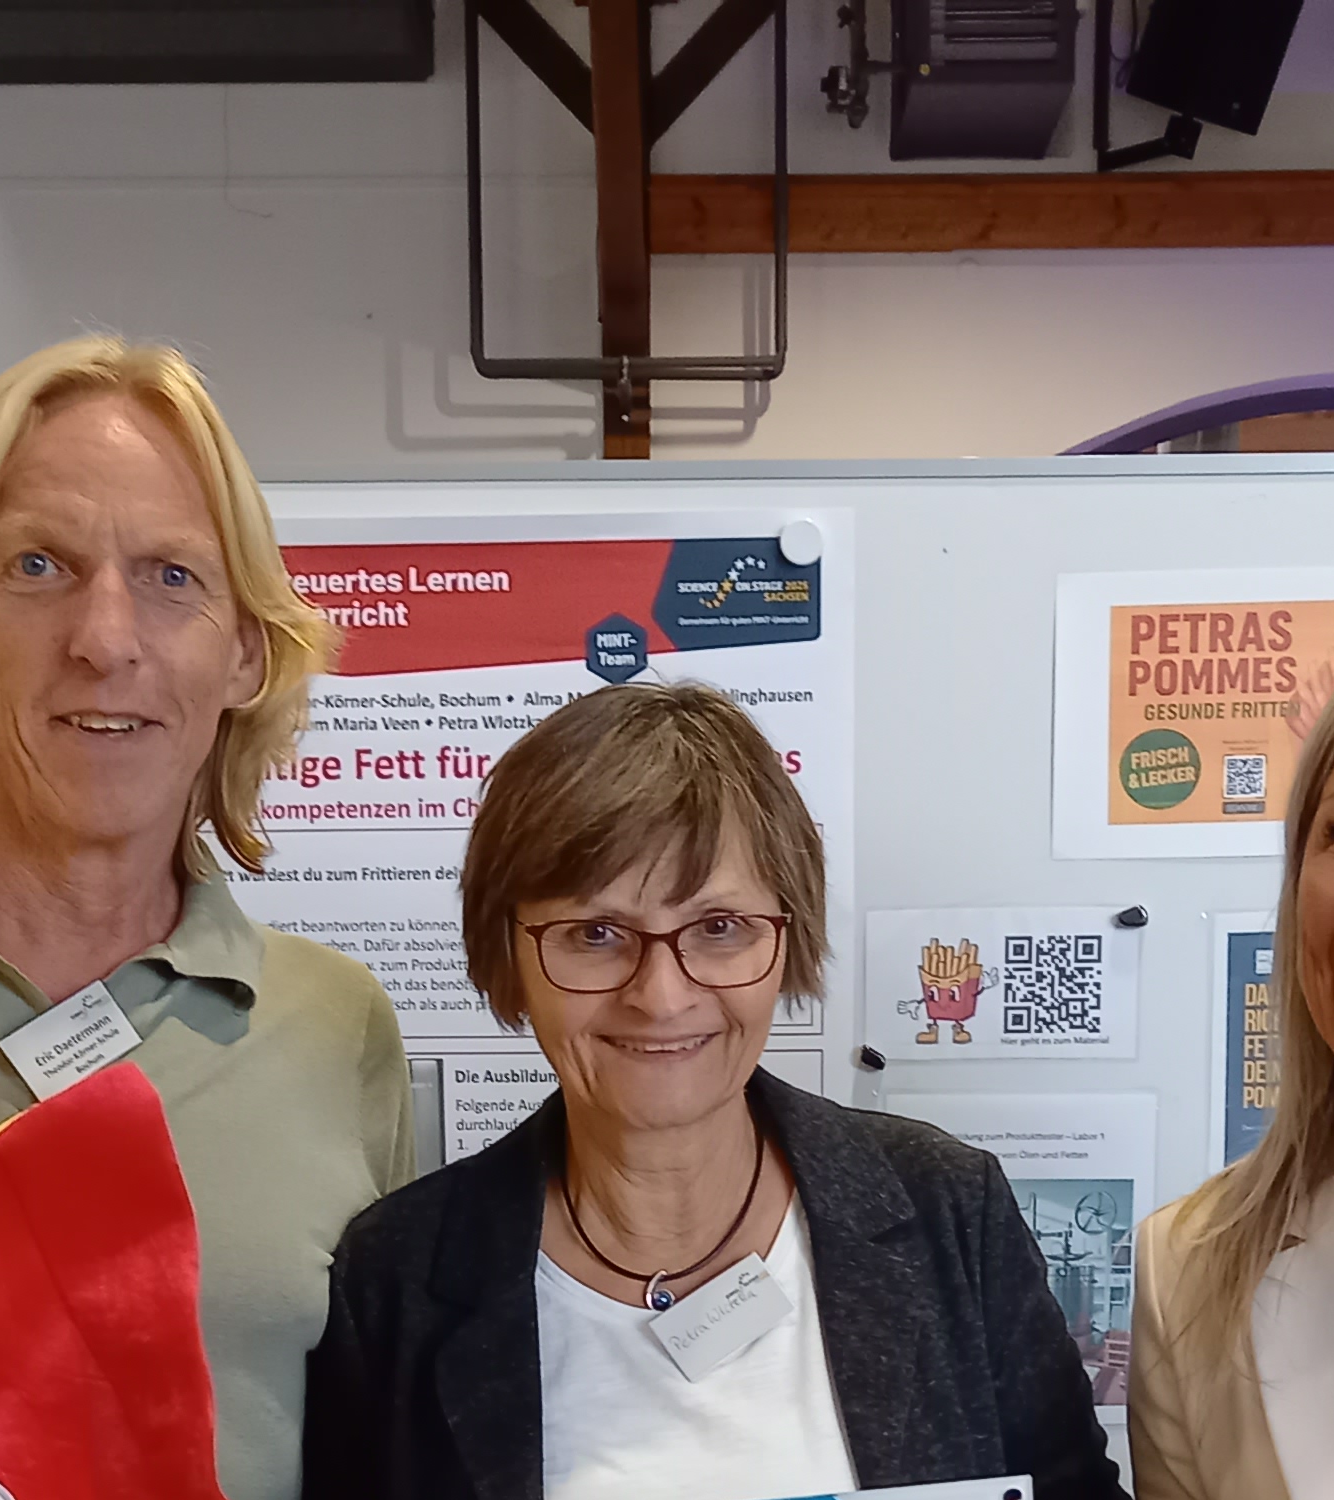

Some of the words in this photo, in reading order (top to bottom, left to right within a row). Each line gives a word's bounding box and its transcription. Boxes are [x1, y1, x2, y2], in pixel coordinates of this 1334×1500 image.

[289, 569, 403, 593] euertes
[408, 567, 510, 592] Lernen
[1130, 610, 1293, 655] PETRAS
[596, 633, 638, 649] MINT-
[598, 652, 635, 666] Team
[1128, 656, 1297, 696] POMMES
[439, 693, 501, 707] Bochum
[523, 692, 562, 706] Alma
[1144, 702, 1225, 721] GESUNDE
[334, 717, 378, 731] Maria
[381, 718, 419, 731] Veen
[439, 716, 478, 730] Petra
[356, 749, 425, 780] Fett
[437, 746, 491, 778] für
[1130, 747, 1189, 769] FRISCH
[1128, 774, 1140, 789] &
[1142, 767, 1197, 788] LECKER
[419, 798, 445, 817] im
[303, 867, 322, 881] du
[326, 871, 357, 881] zum
[362, 866, 432, 882] Frittieren
[301, 919, 387, 933] beantworten
[364, 939, 400, 952] Dafür
[380, 961, 408, 972] zum
[405, 978, 427, 992] das
[419, 998, 437, 1011] als
[441, 998, 471, 1012] auch
[455, 1070, 479, 1083] Die
[483, 1069, 561, 1084] Ausbildun
[456, 1099, 515, 1114] Folgende
